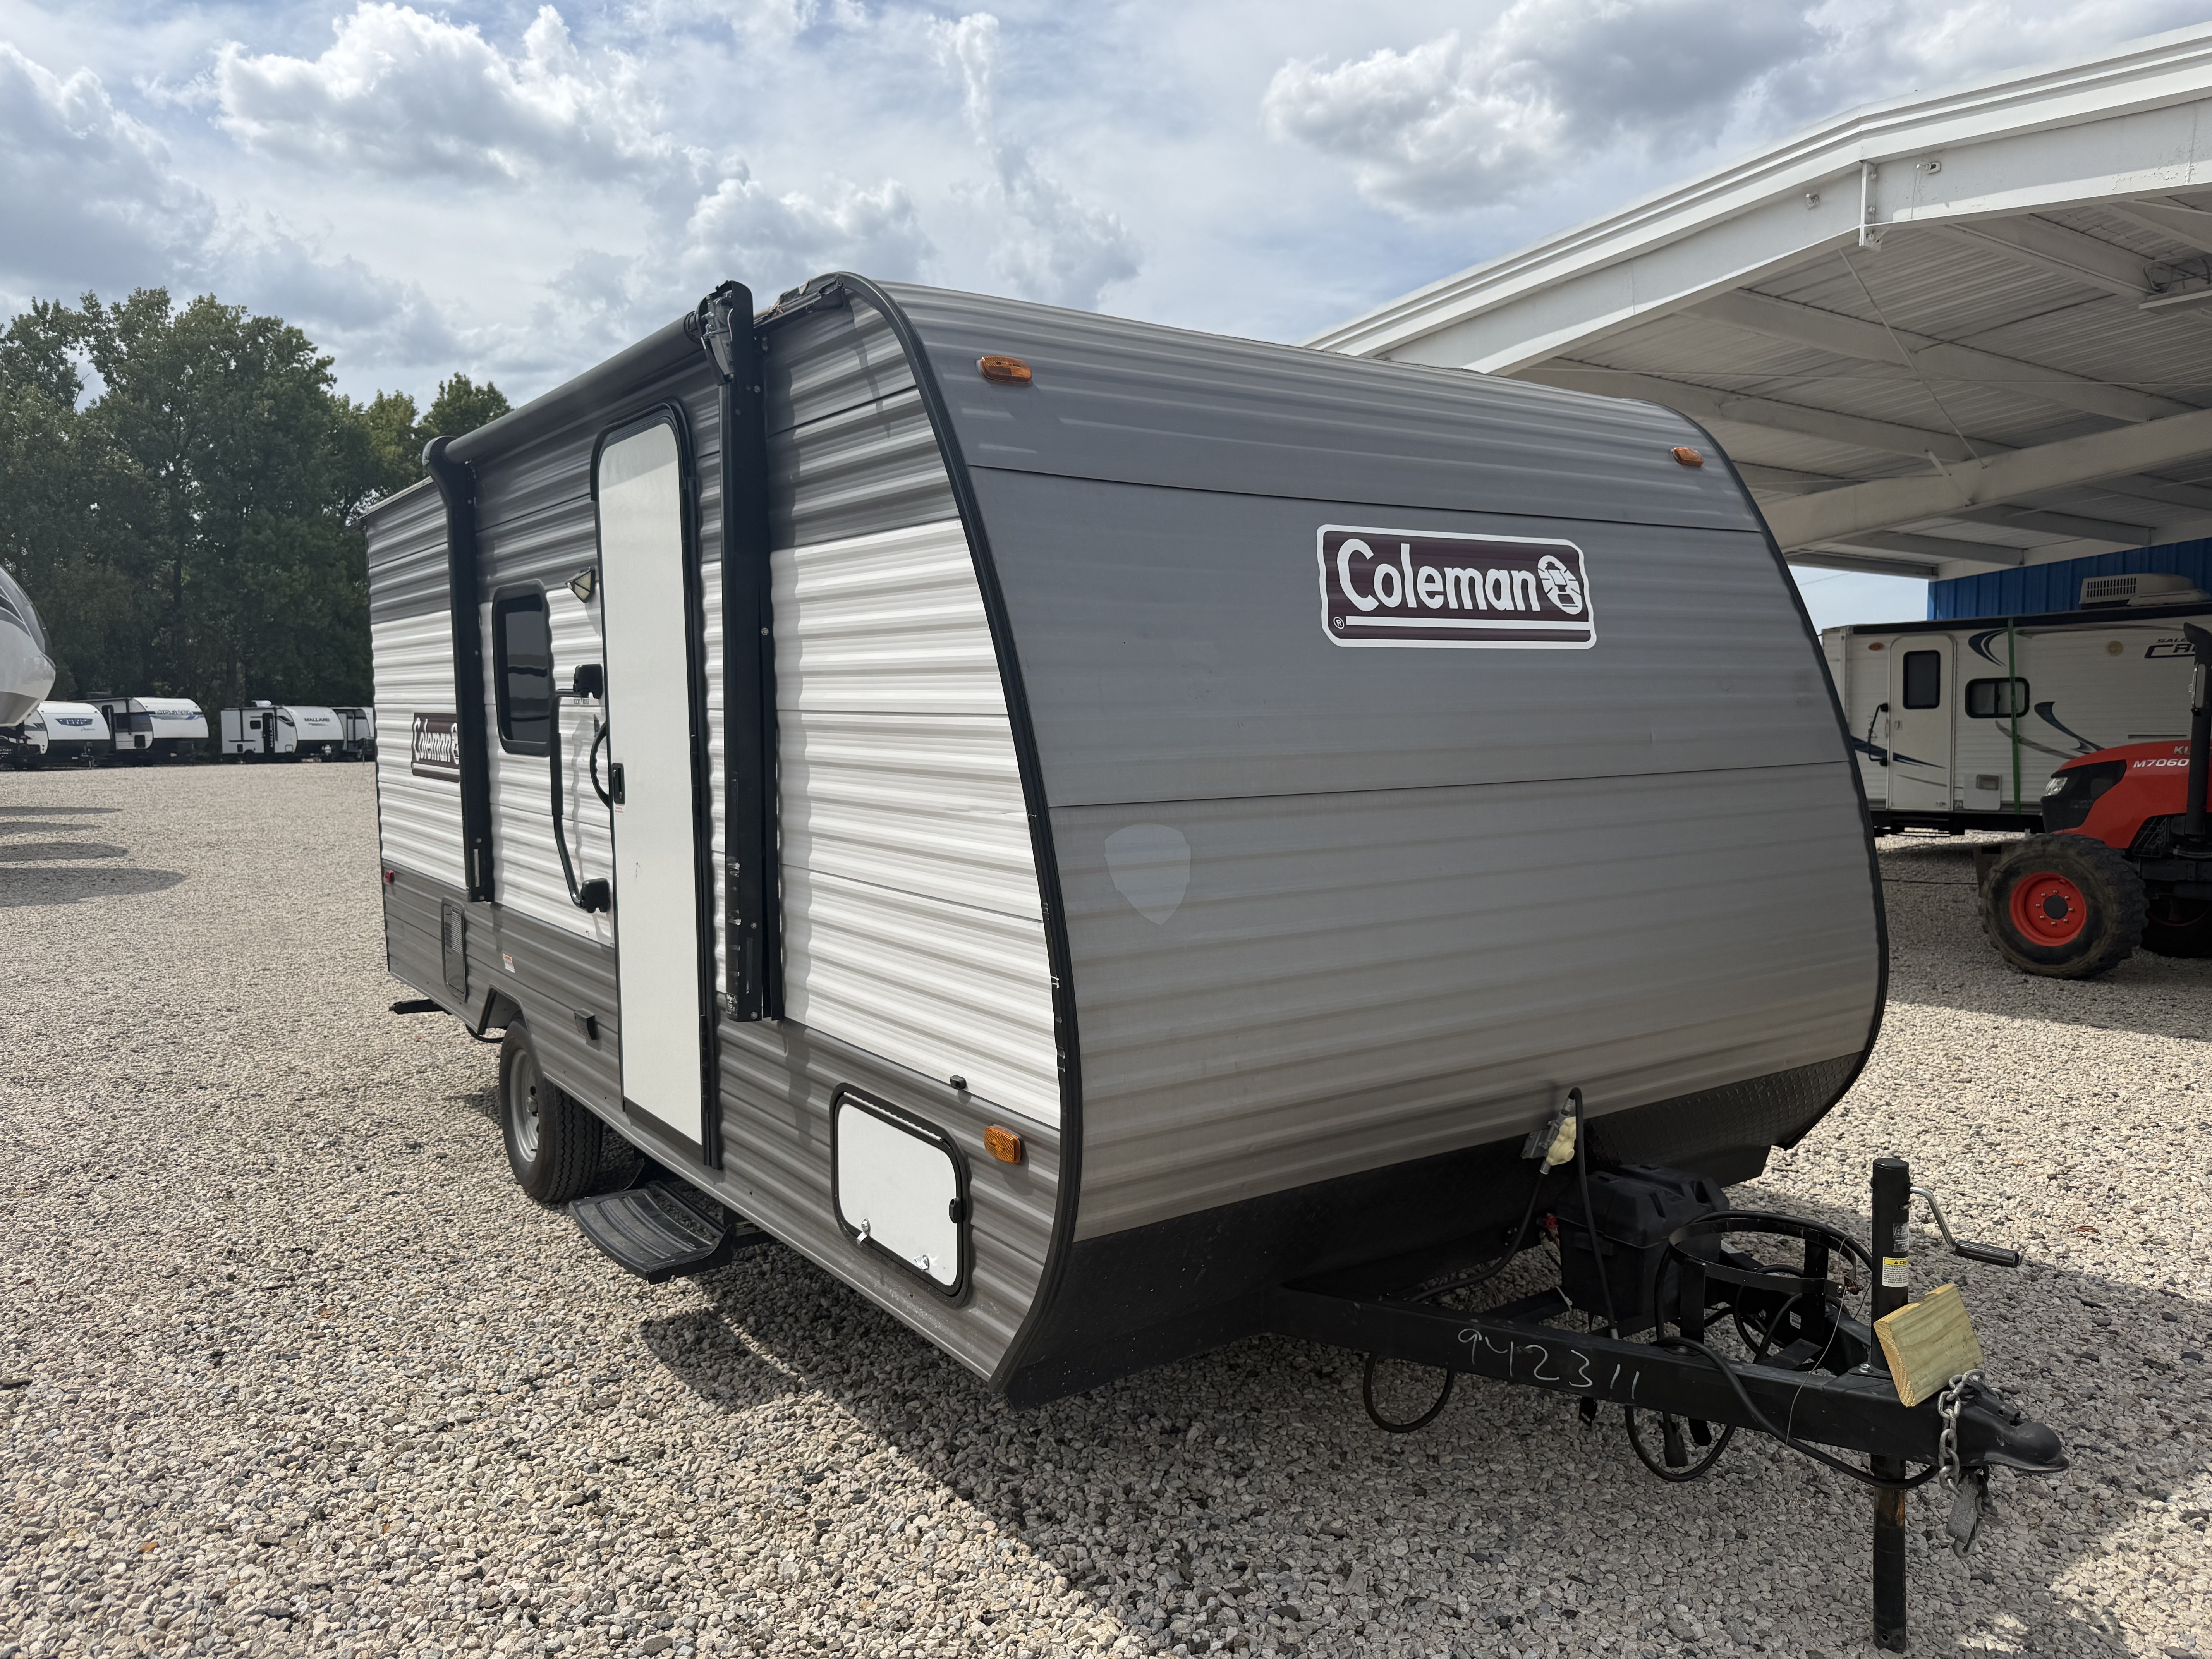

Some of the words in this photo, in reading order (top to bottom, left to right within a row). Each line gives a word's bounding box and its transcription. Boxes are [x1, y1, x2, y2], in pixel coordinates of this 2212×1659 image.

[1337, 538, 1540, 612] Coleman
[413, 717, 451, 762] Coleman
[2133, 759, 2190, 768] M7060
